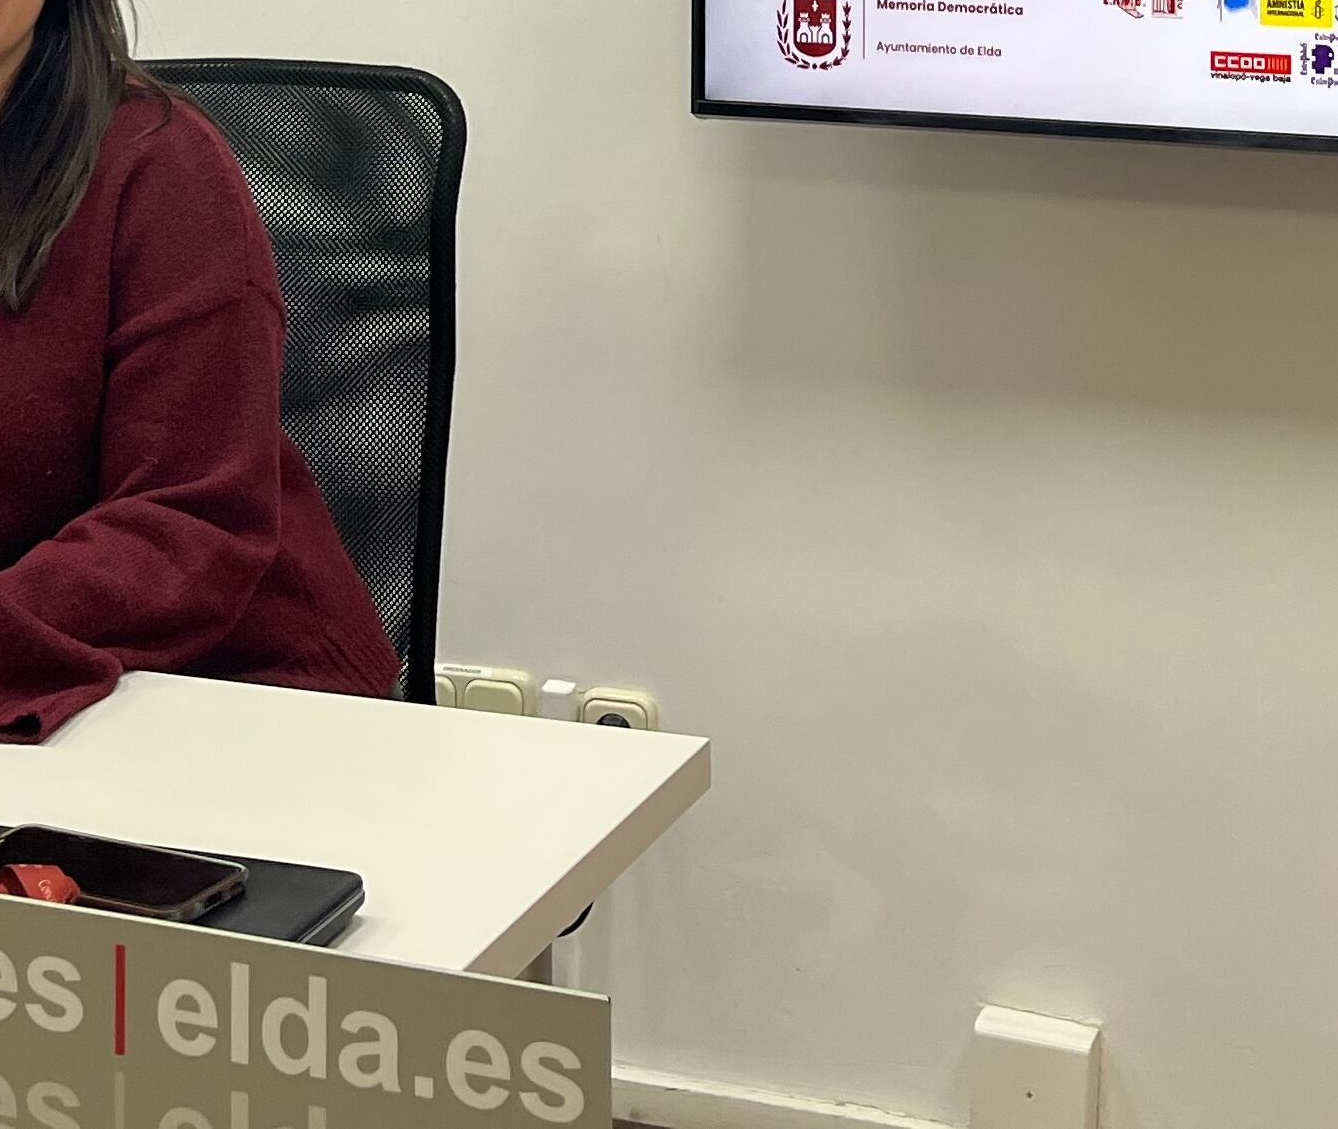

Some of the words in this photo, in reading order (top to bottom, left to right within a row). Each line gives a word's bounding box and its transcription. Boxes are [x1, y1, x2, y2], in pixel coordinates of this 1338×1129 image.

[937, 0, 1024, 16] Democrática
[876, 41, 958, 56] Ayuntamiento
[959, 44, 975, 57] de
[977, 45, 1002, 57] Elda
[1214, 55, 1266, 70] CCOO
[157, 963, 586, 1124] elda.es
